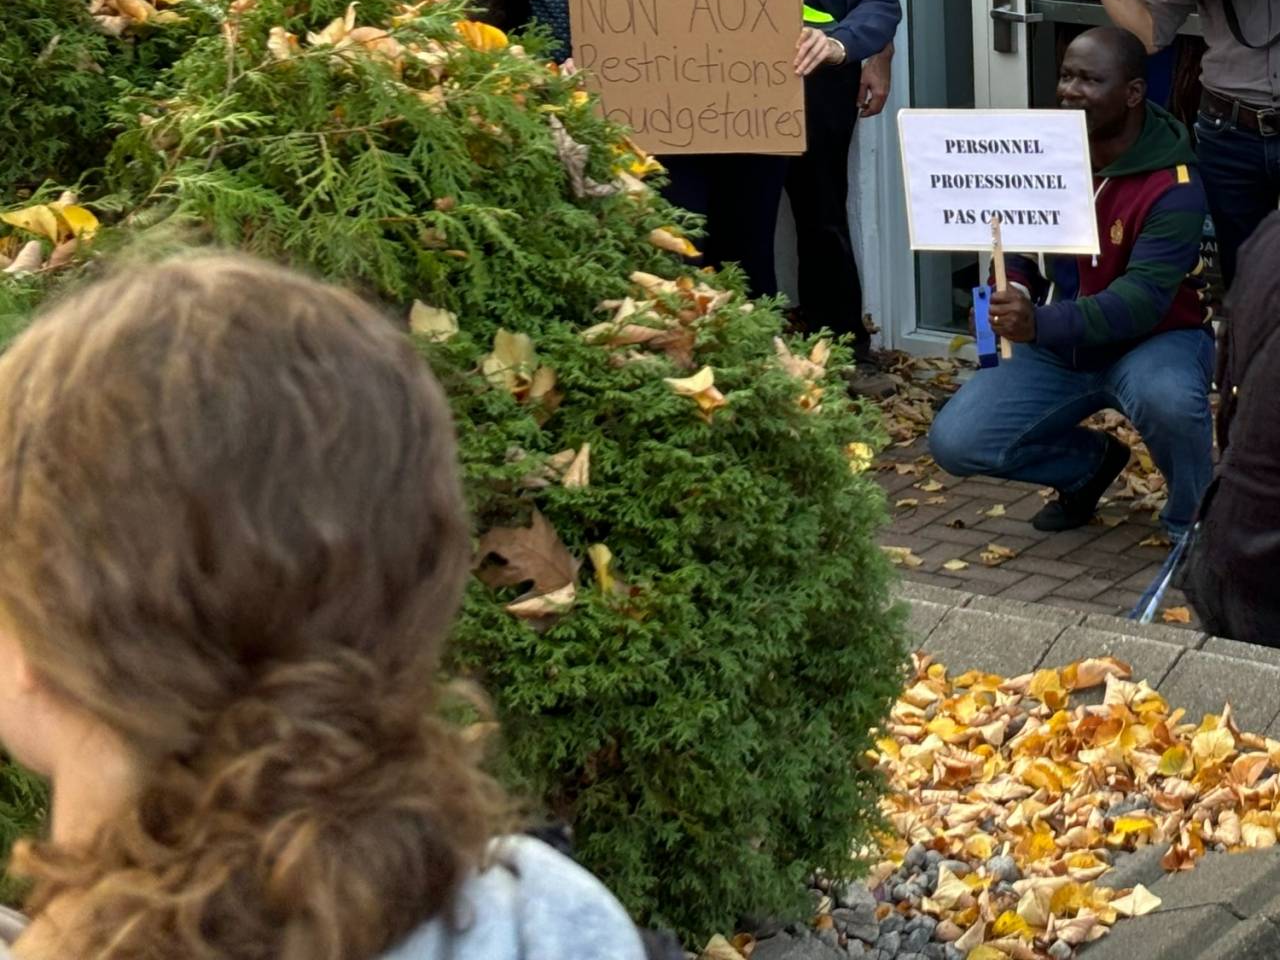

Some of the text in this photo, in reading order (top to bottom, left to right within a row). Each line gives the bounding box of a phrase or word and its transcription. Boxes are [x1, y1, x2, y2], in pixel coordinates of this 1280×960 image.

[579, 41, 788, 89] Restrictions
[945, 139, 1044, 154] PERSONNEL
[930, 174, 1067, 190] PROFESSIONNEL
[943, 209, 1060, 226] PAS CONTENT
